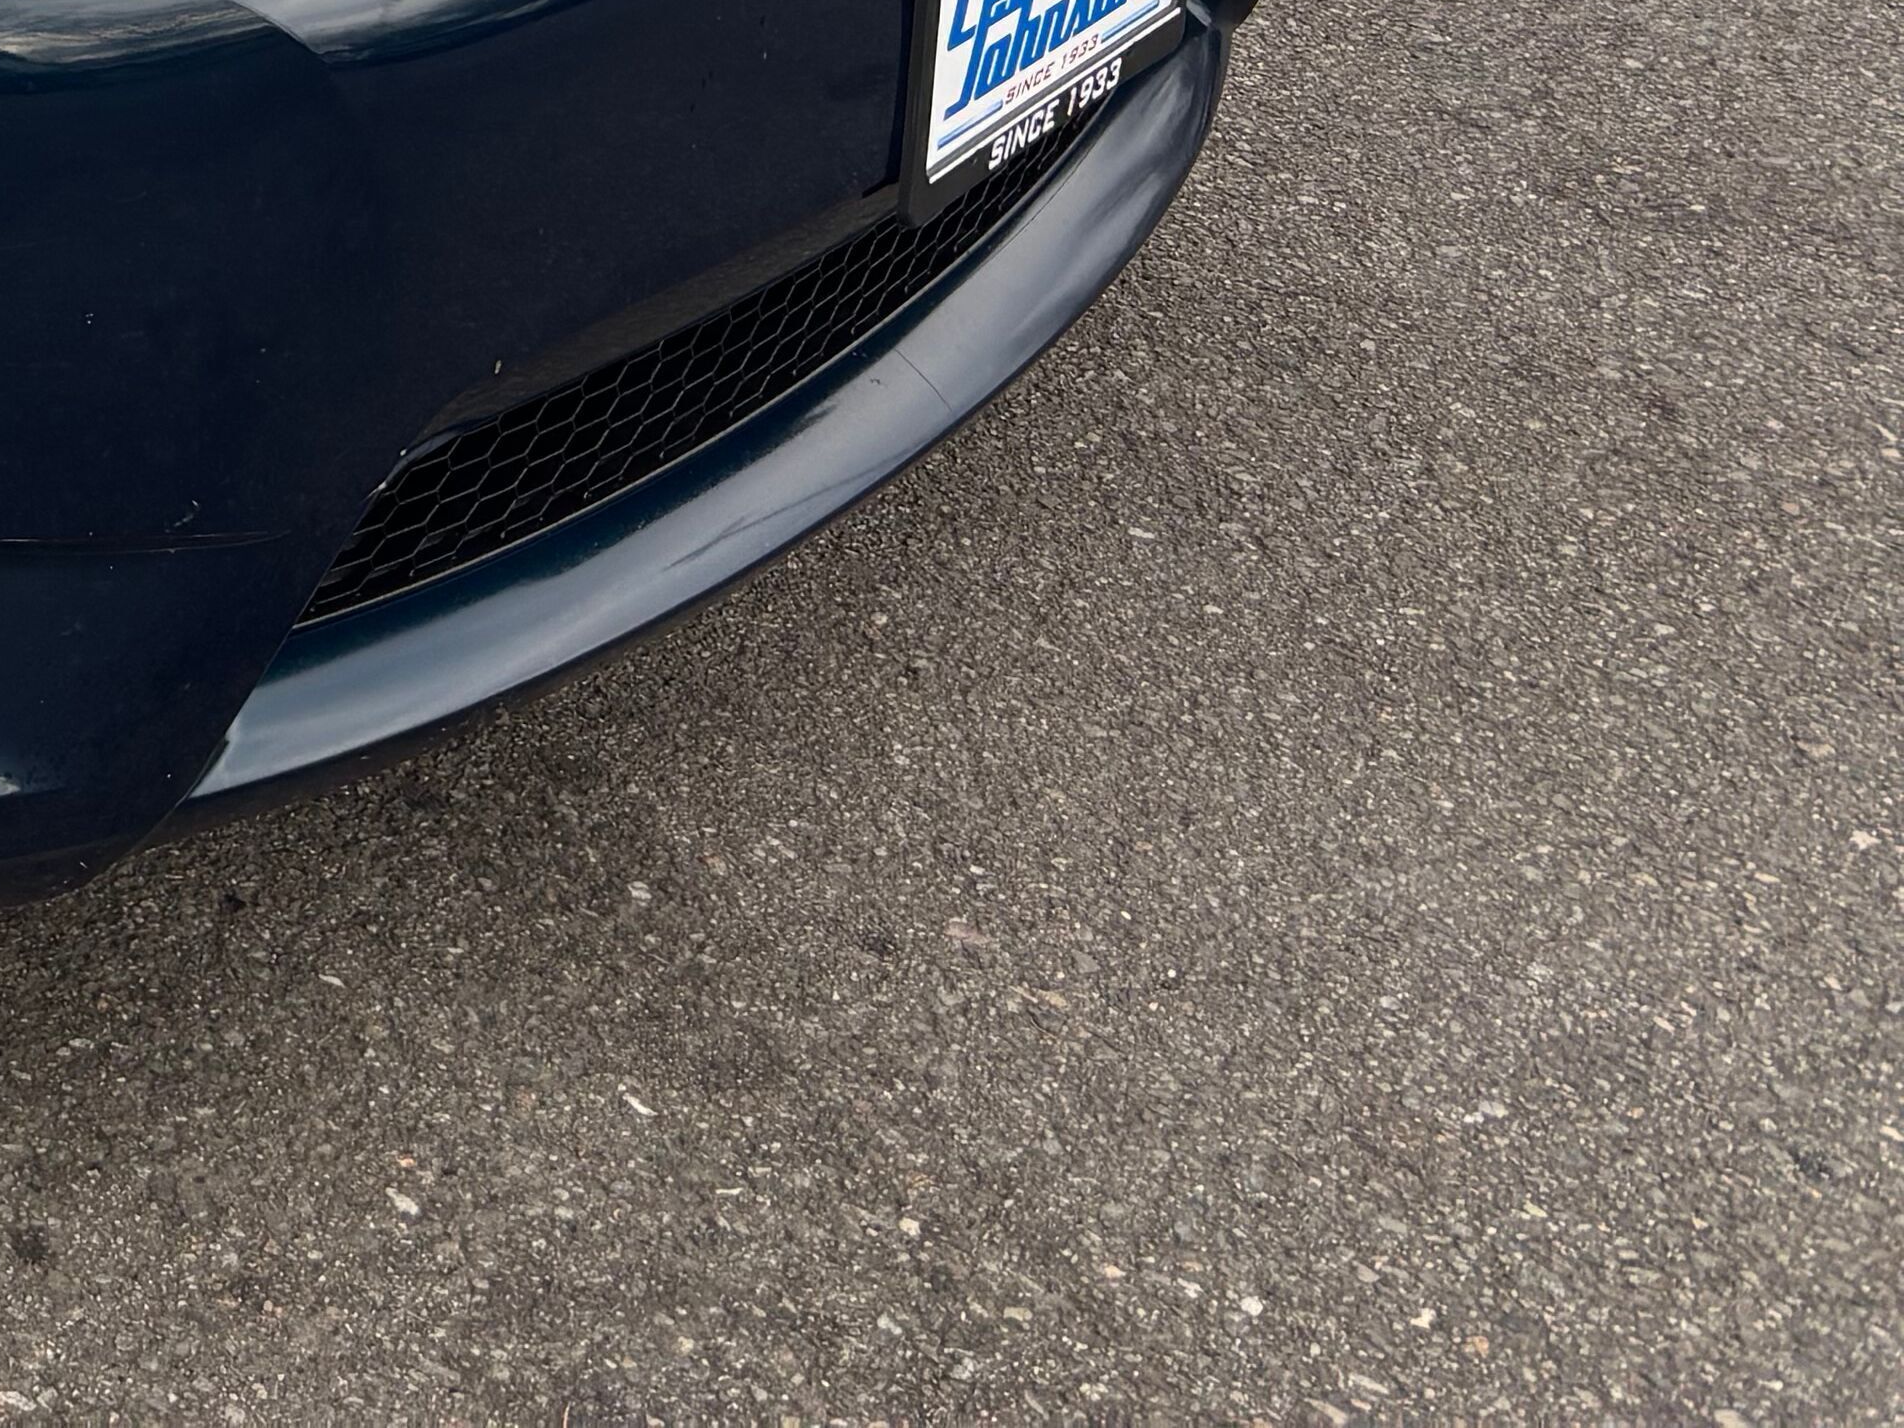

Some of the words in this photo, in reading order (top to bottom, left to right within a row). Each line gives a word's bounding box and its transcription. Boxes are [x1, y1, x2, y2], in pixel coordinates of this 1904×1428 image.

[988, 98, 1060, 170] SINCE
[1067, 57, 1123, 118] 1933
[1005, 61, 1054, 106] SINCE
[1059, 33, 1099, 71] 1933
